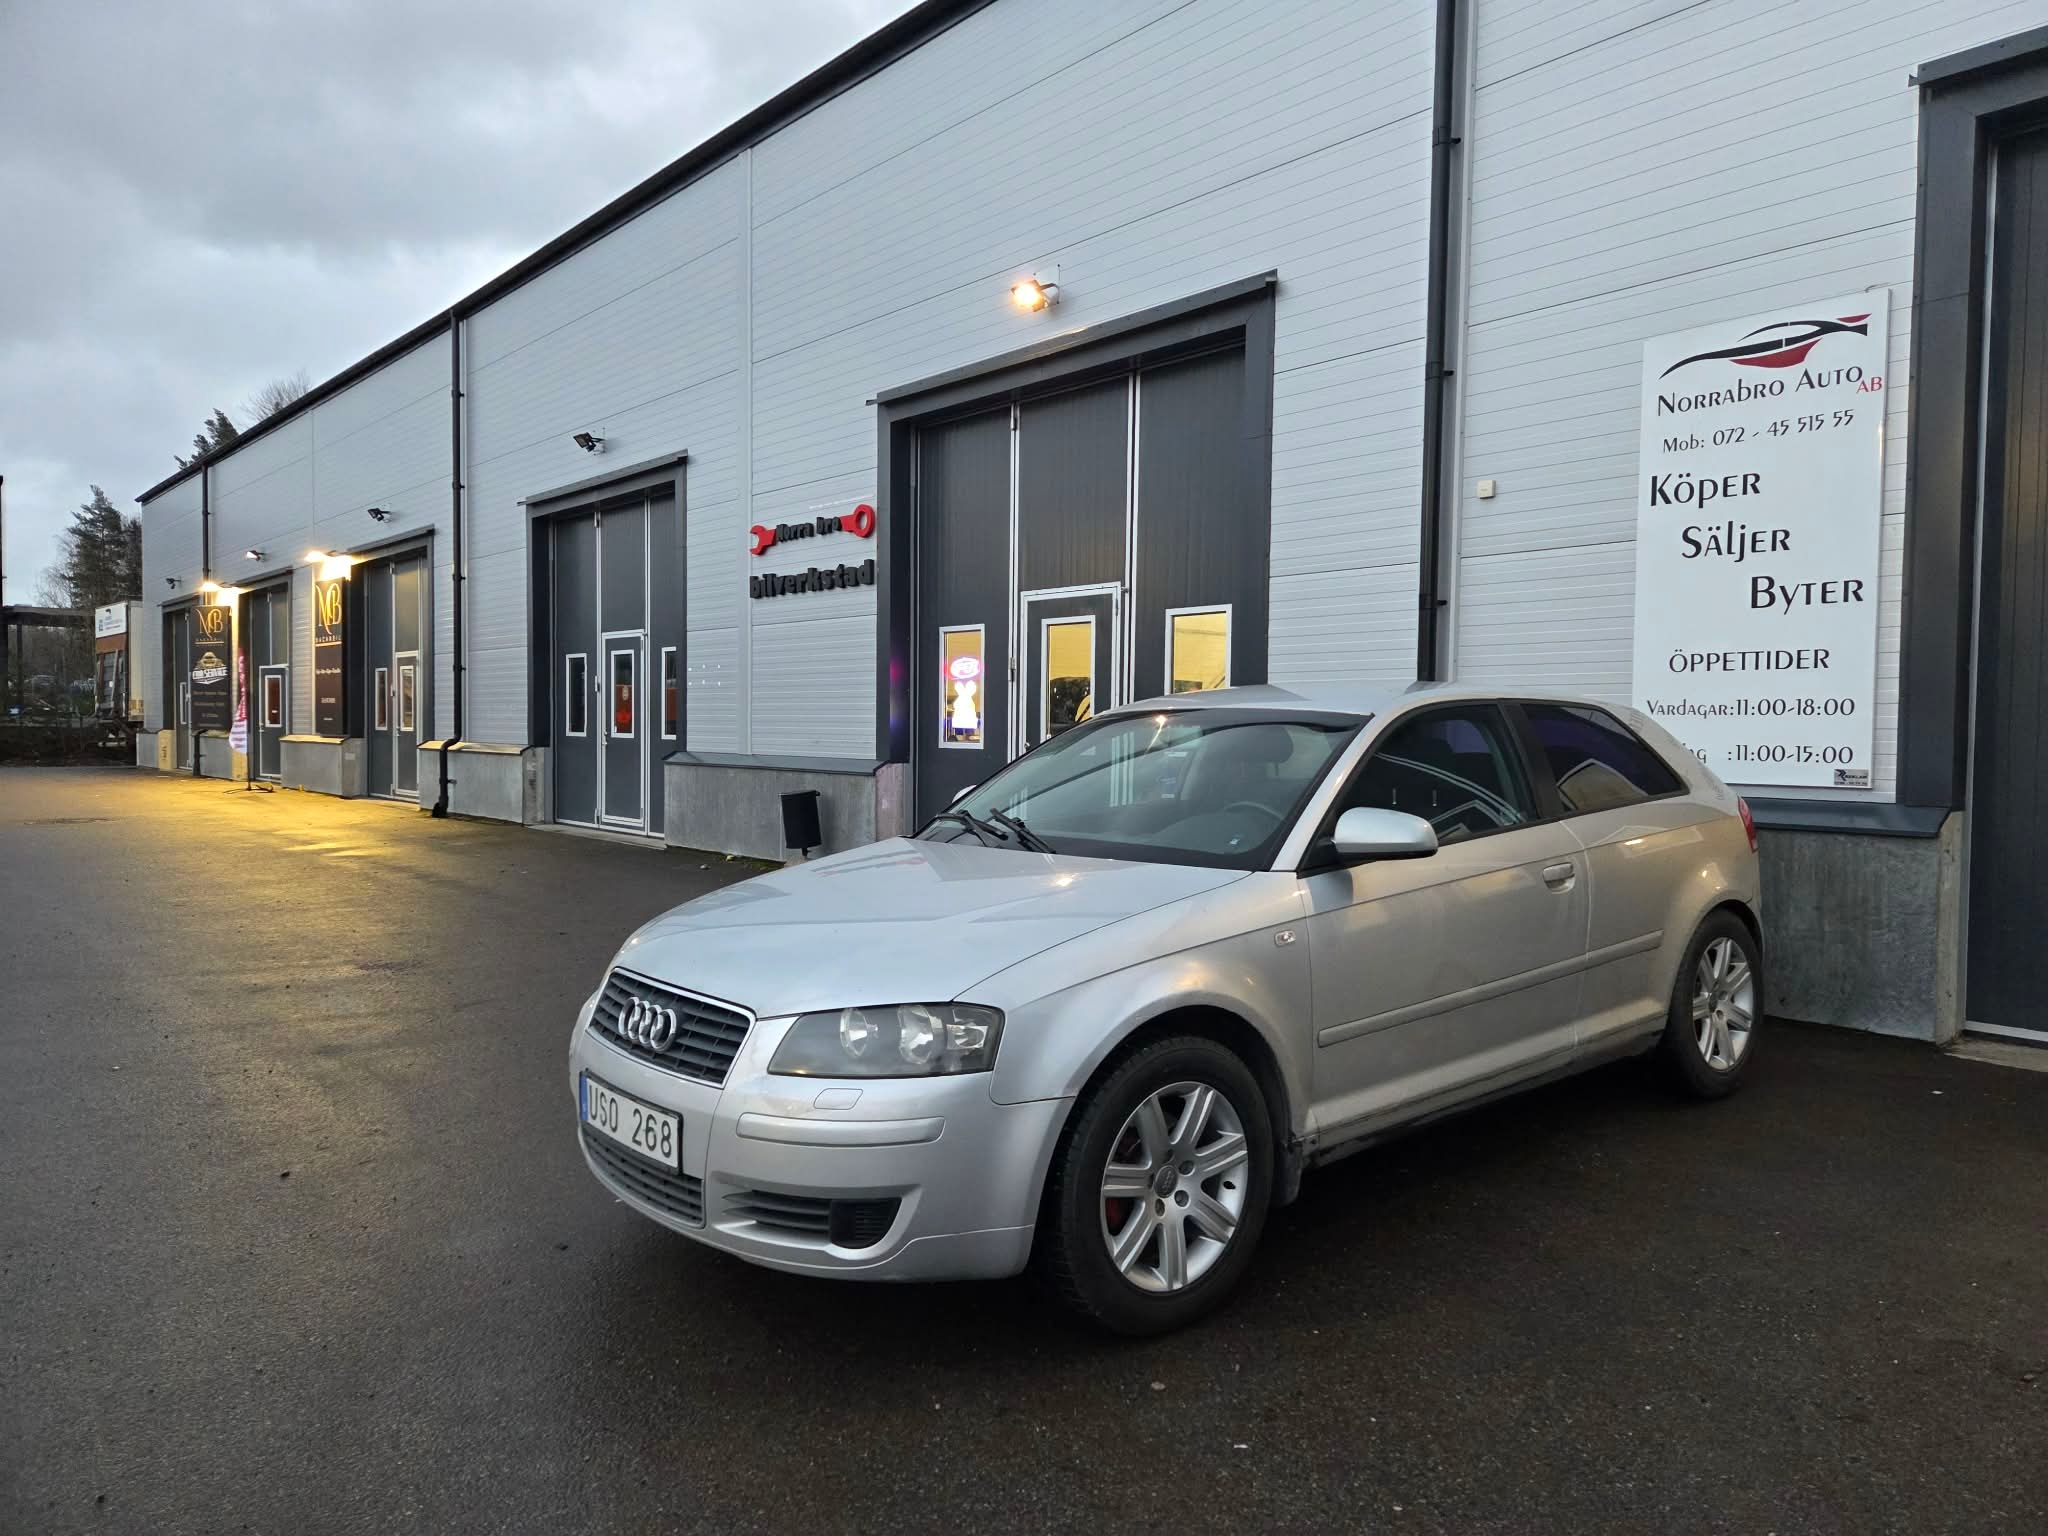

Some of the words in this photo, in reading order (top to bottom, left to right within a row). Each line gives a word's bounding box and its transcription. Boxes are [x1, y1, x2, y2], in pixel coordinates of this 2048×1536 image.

[1856, 376, 1883, 394] AB
[1663, 433, 1705, 453] Mob:
[1713, 425, 1745, 447] 072
[1767, 418, 1790, 437] 45
[1797, 413, 1825, 433] 515
[1833, 408, 1855, 427] 55
[1669, 647, 1830, 674] ÖPPETTIDER
[589, 1084, 618, 1133] USO
[631, 1107, 672, 1159] 268
